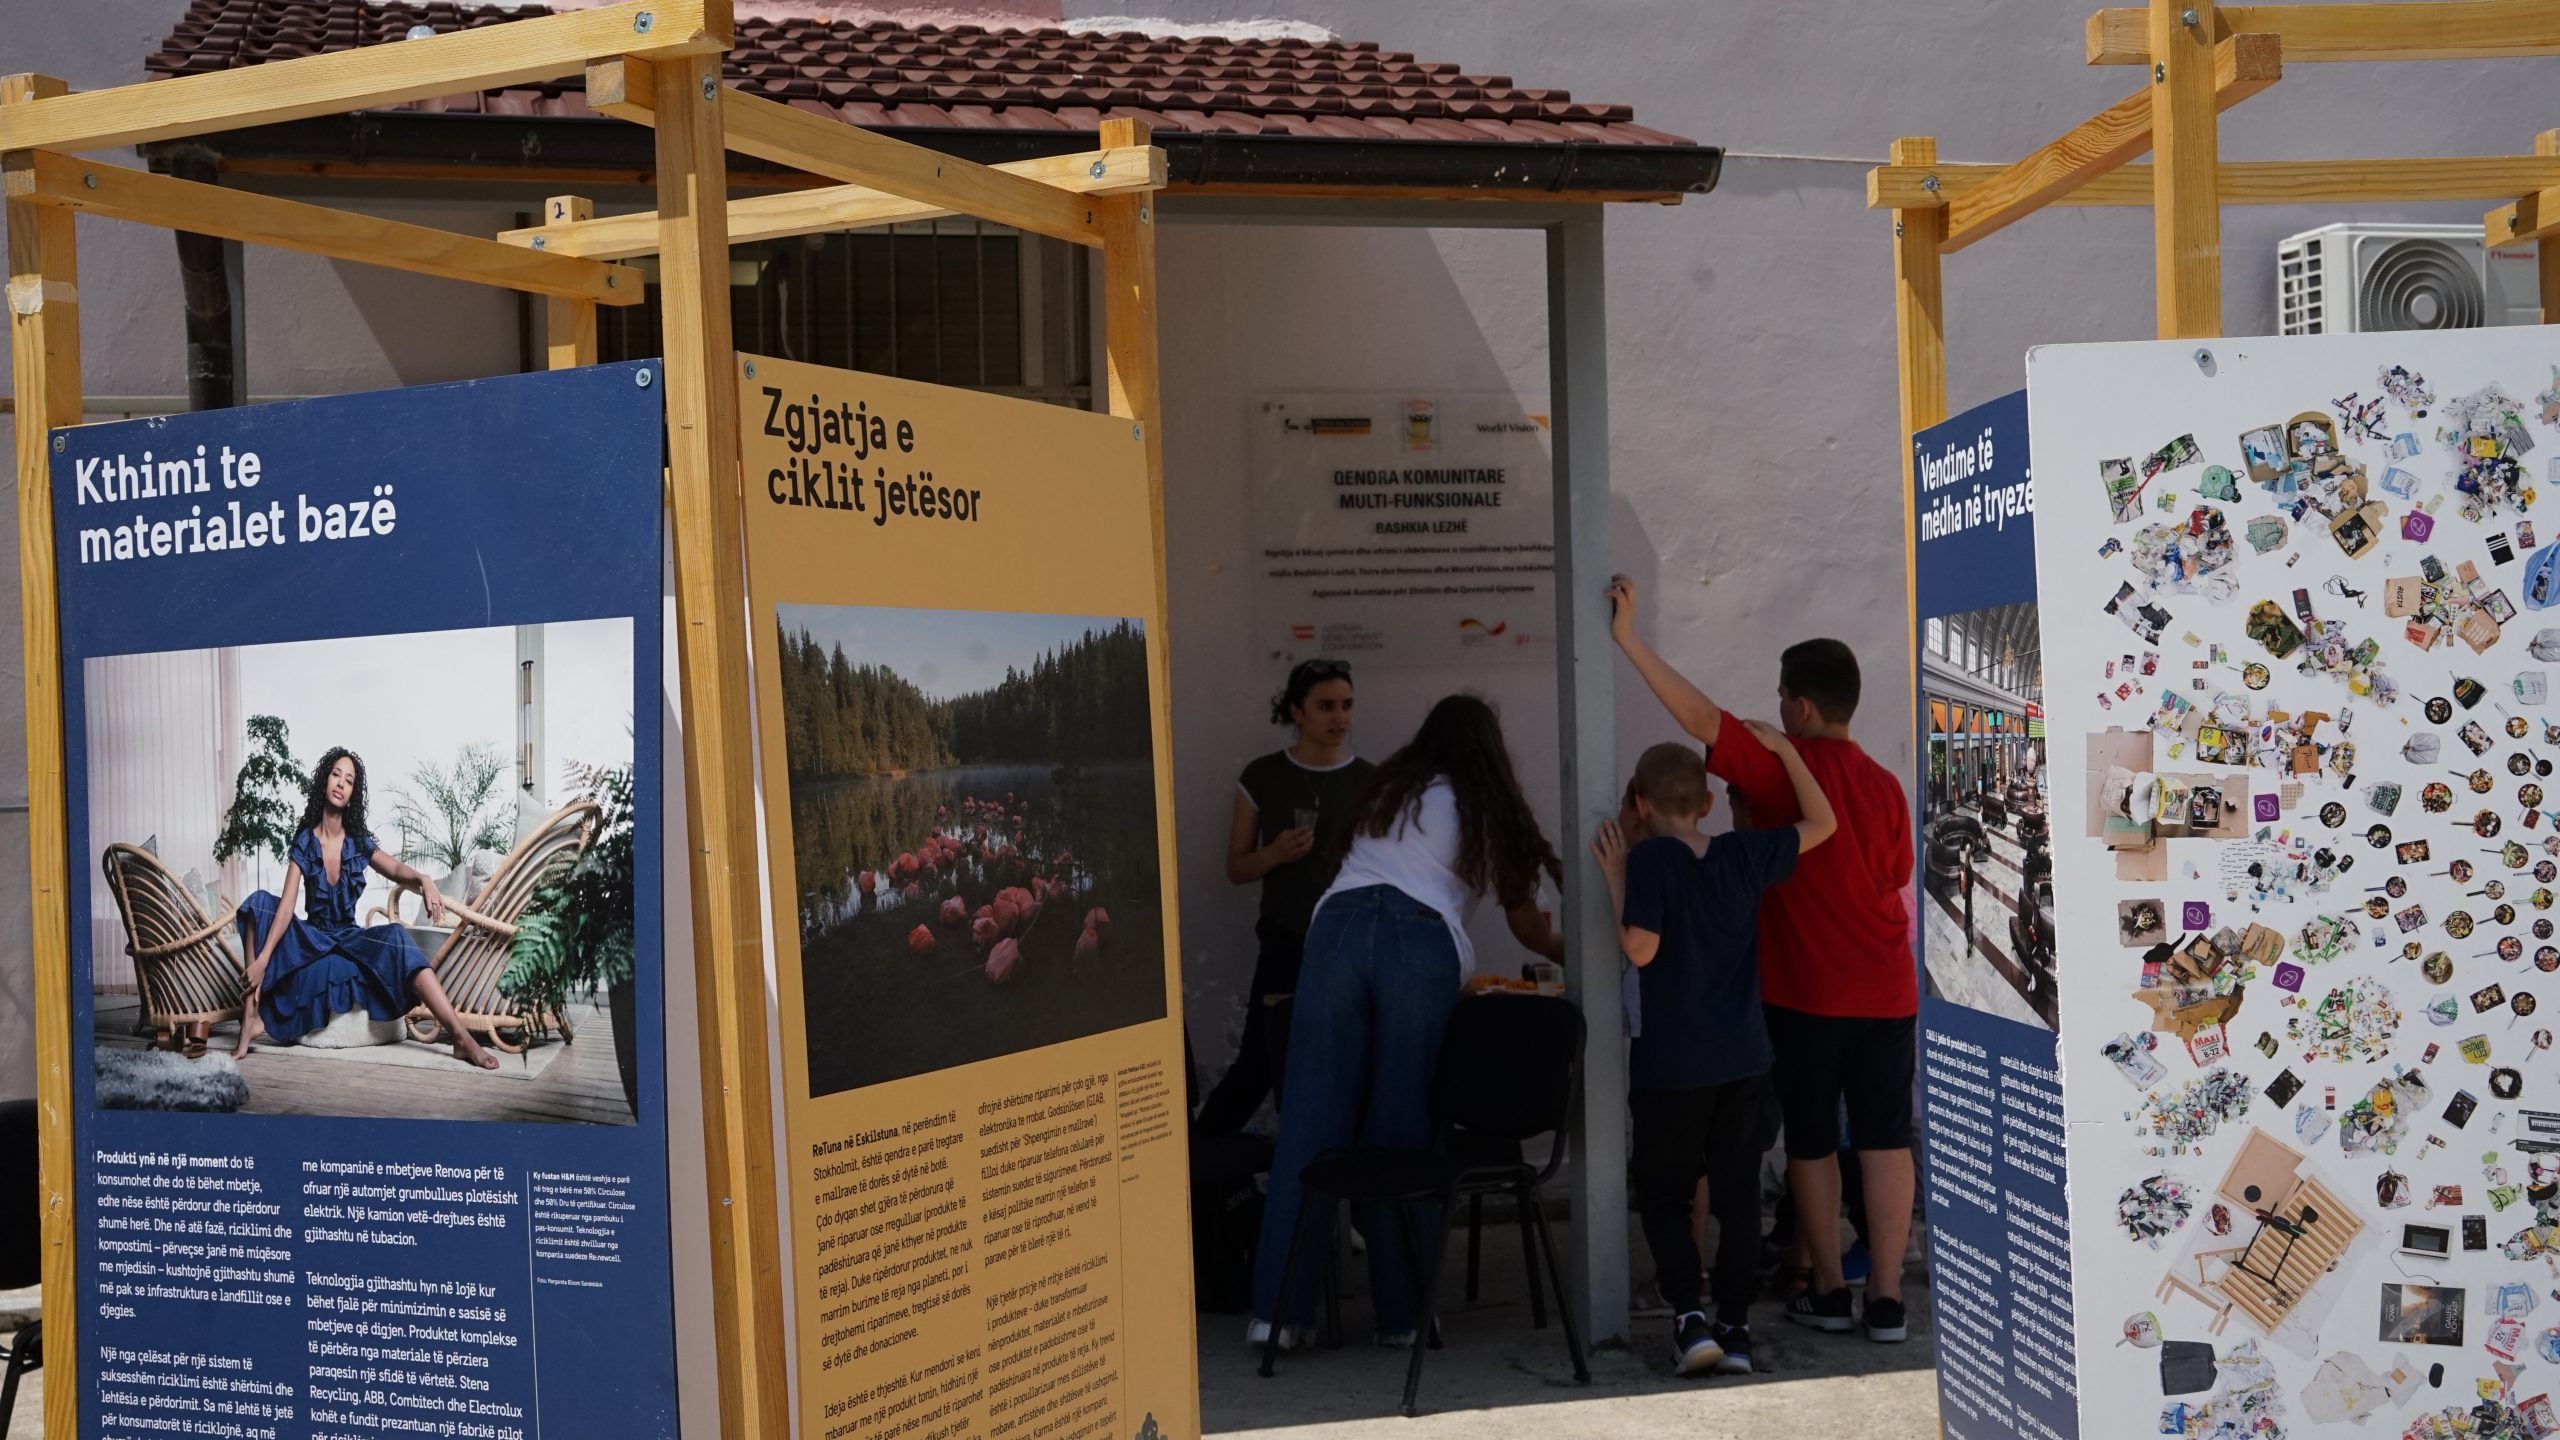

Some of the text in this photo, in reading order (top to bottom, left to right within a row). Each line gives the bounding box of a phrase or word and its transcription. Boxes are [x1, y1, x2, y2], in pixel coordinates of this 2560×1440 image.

[762, 386, 914, 460] Zgjatja e
[1477, 422, 1539, 433] World Vision
[1920, 427, 1993, 492] Vendime të
[76, 445, 261, 505] Kthimi te
[1334, 469, 1506, 487] QENDRA KOMUNITARE
[768, 456, 981, 527] ciklit jetësor
[1339, 492, 1502, 510] MULTI-FUNKSIONALE
[80, 484, 396, 564] materialet bazë
[1922, 495, 1962, 542] mëdha
[1965, 483, 1982, 529] në
[1376, 519, 1468, 534] BASHKIA LEZHË
[2194, 1034, 2220, 1047] MAXI
[812, 1141, 842, 1157] ReTuna
[843, 1135, 854, 1150] në
[902, 1121, 911, 1134] në
[912, 1113, 947, 1135] perëndim
[948, 1110, 956, 1123] të
[97, 1150, 254, 1169] Produkti ynë në një moment do të
[861, 1151, 882, 1168] është
[884, 1145, 910, 1165] qendra
[911, 1145, 916, 1155] e
[918, 1137, 934, 1157] parë
[935, 1133, 963, 1150] tregtare
[302, 1159, 504, 1182] me kompaninë e mbetjeve Renova për të
[97, 1172, 262, 1195] konsumohet dhe do të bëhet mbetje,
[303, 1181, 518, 1205] ofruar një automjet grumbullues plotësisht
[98, 1215, 292, 1238] shumë herë. Dhe në atë fazë, riciklimi dhe
[303, 1203, 505, 1228] elektrik. Një kamion vetë-drejtues është
[304, 1227, 417, 1246] gjithashtu në tubacion.
[99, 1281, 291, 1306] më pak se infrastruktura e landfillit ose e
[305, 1271, 496, 1299] Teknologjia gjithashtu hyn në lojë kur
[99, 1302, 136, 1319] djegies.
[307, 1317, 517, 1347] mbetjeve që digjen. Produktet komplekse
[100, 1346, 252, 1370] Një nga çelësat për një sistem të
[822, 1327, 918, 1371] së dytë dhe donacioneve.
[101, 1368, 293, 1396] suksesshëm riciklimi është shërbimi dhe
[310, 1384, 522, 1418] Recycling, ABB, Combitech dhe Electrolux
